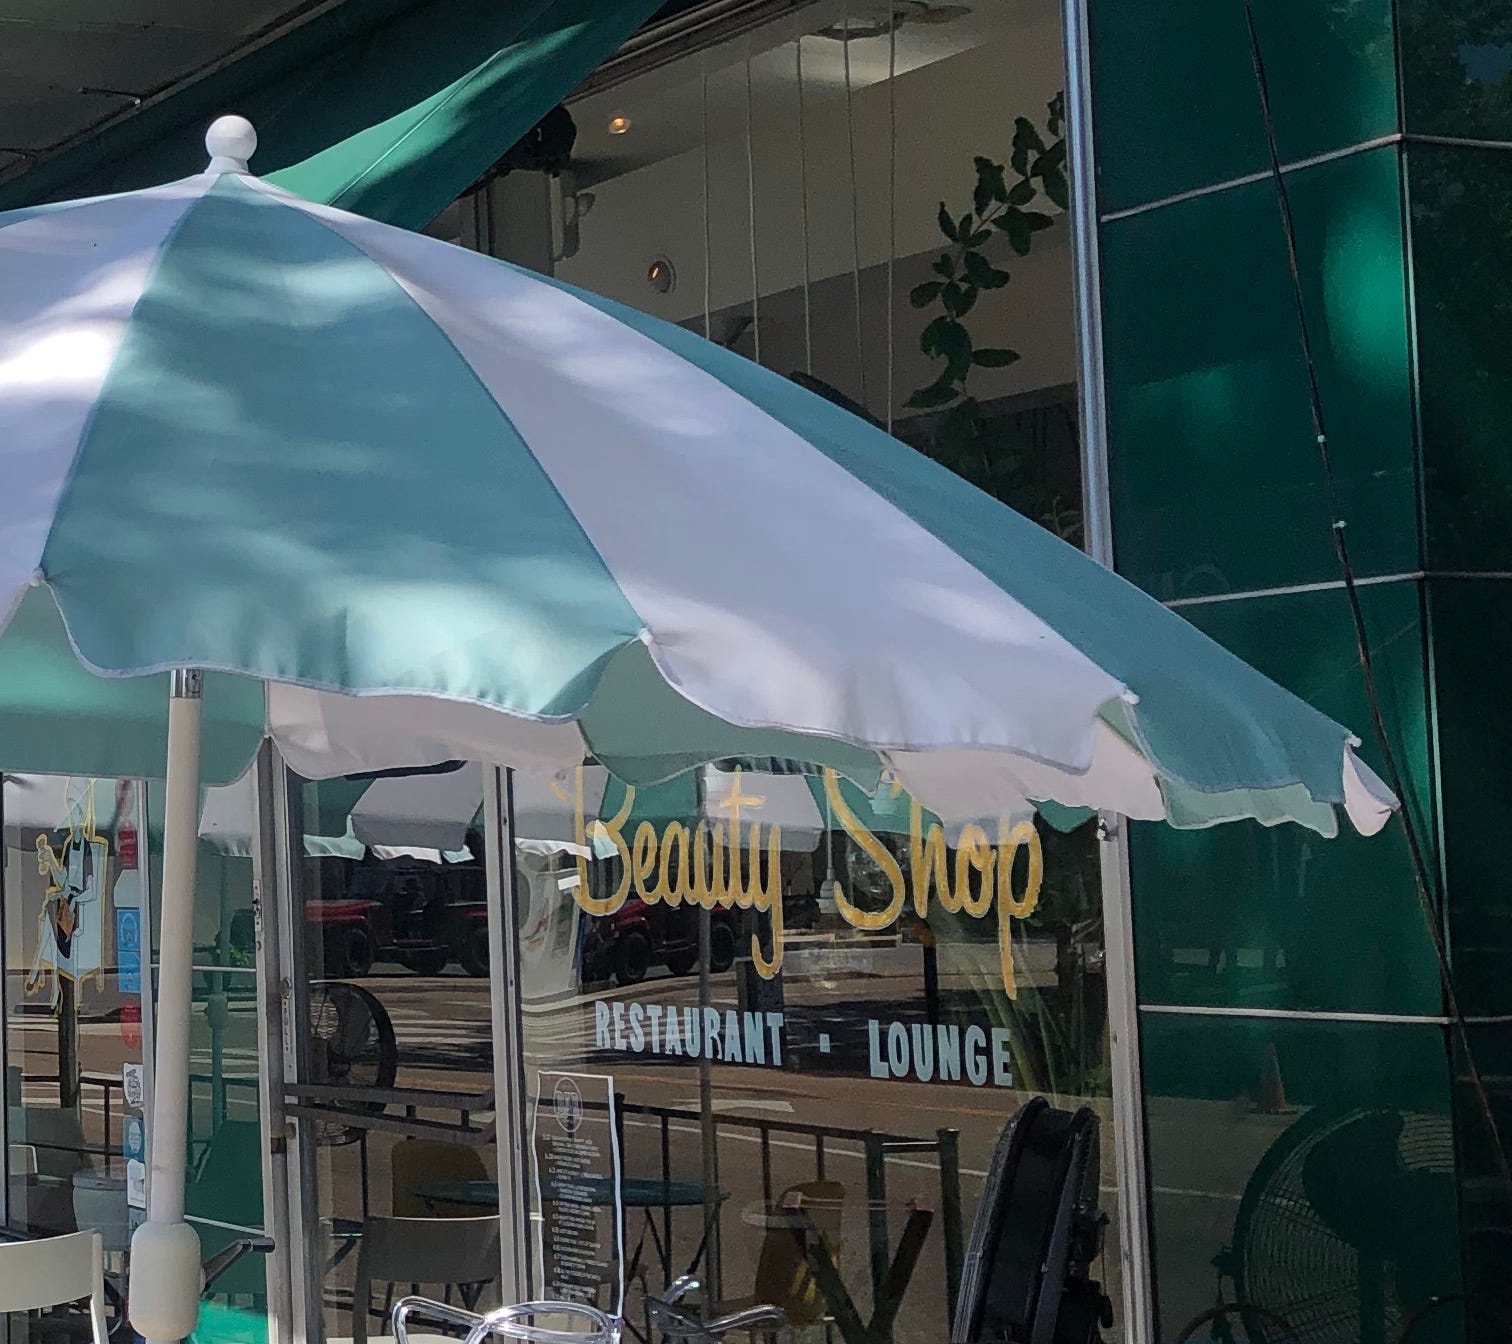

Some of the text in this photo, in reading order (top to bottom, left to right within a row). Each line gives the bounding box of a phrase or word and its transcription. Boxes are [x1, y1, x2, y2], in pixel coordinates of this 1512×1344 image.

[554, 765, 1043, 1000] Beauty Shop
[594, 1000, 1014, 1088] RESTAURANT LOUNGE
